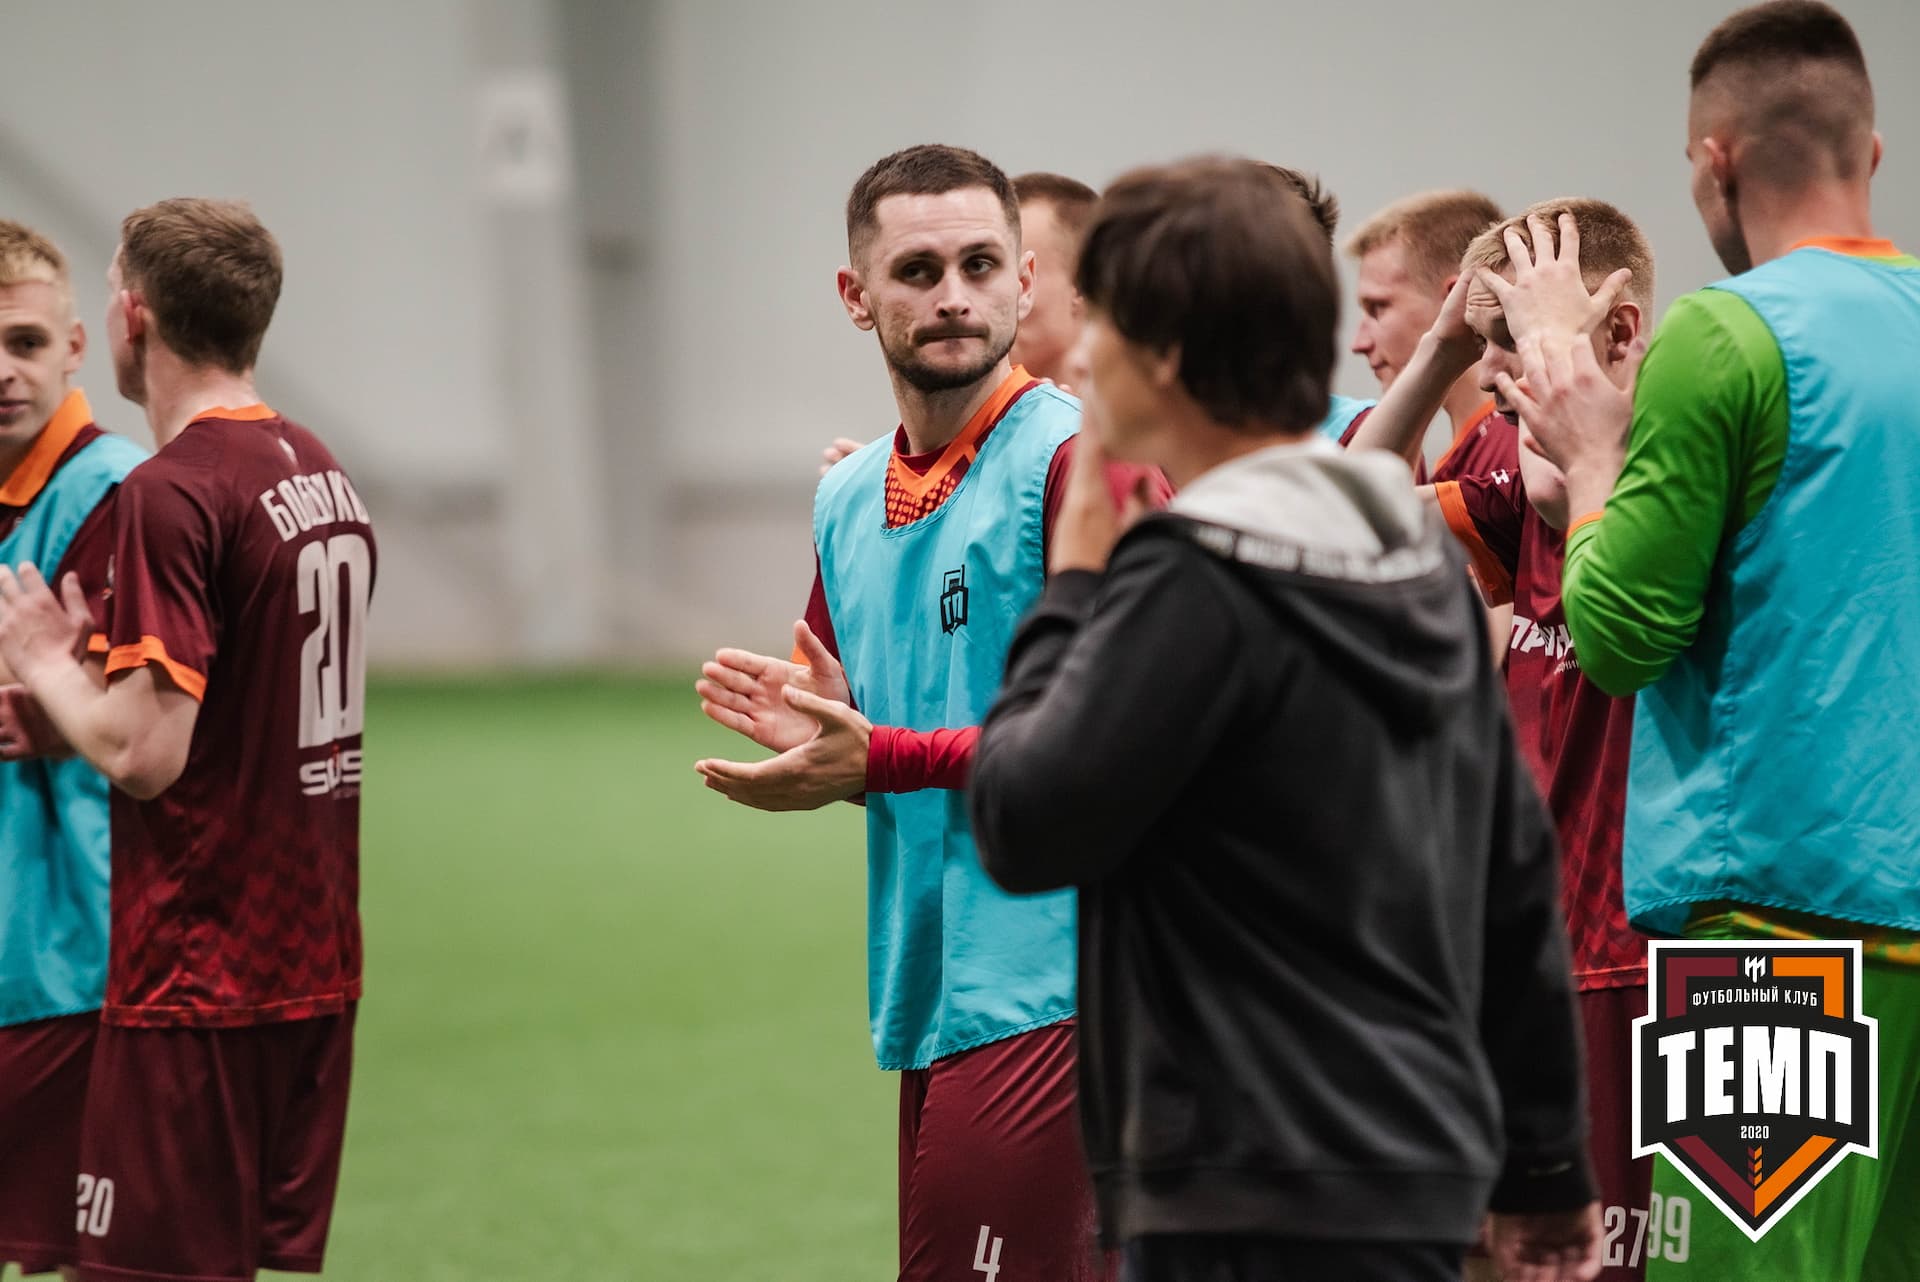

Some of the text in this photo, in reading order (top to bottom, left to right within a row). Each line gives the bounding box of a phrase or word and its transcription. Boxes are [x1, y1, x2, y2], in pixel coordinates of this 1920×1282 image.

[297, 533, 371, 749] 20
[76, 1173, 115, 1237] 20
[1602, 1205, 1649, 1268] 27
[1647, 1191, 1692, 1263] 99
[972, 1224, 1003, 1282] 4
